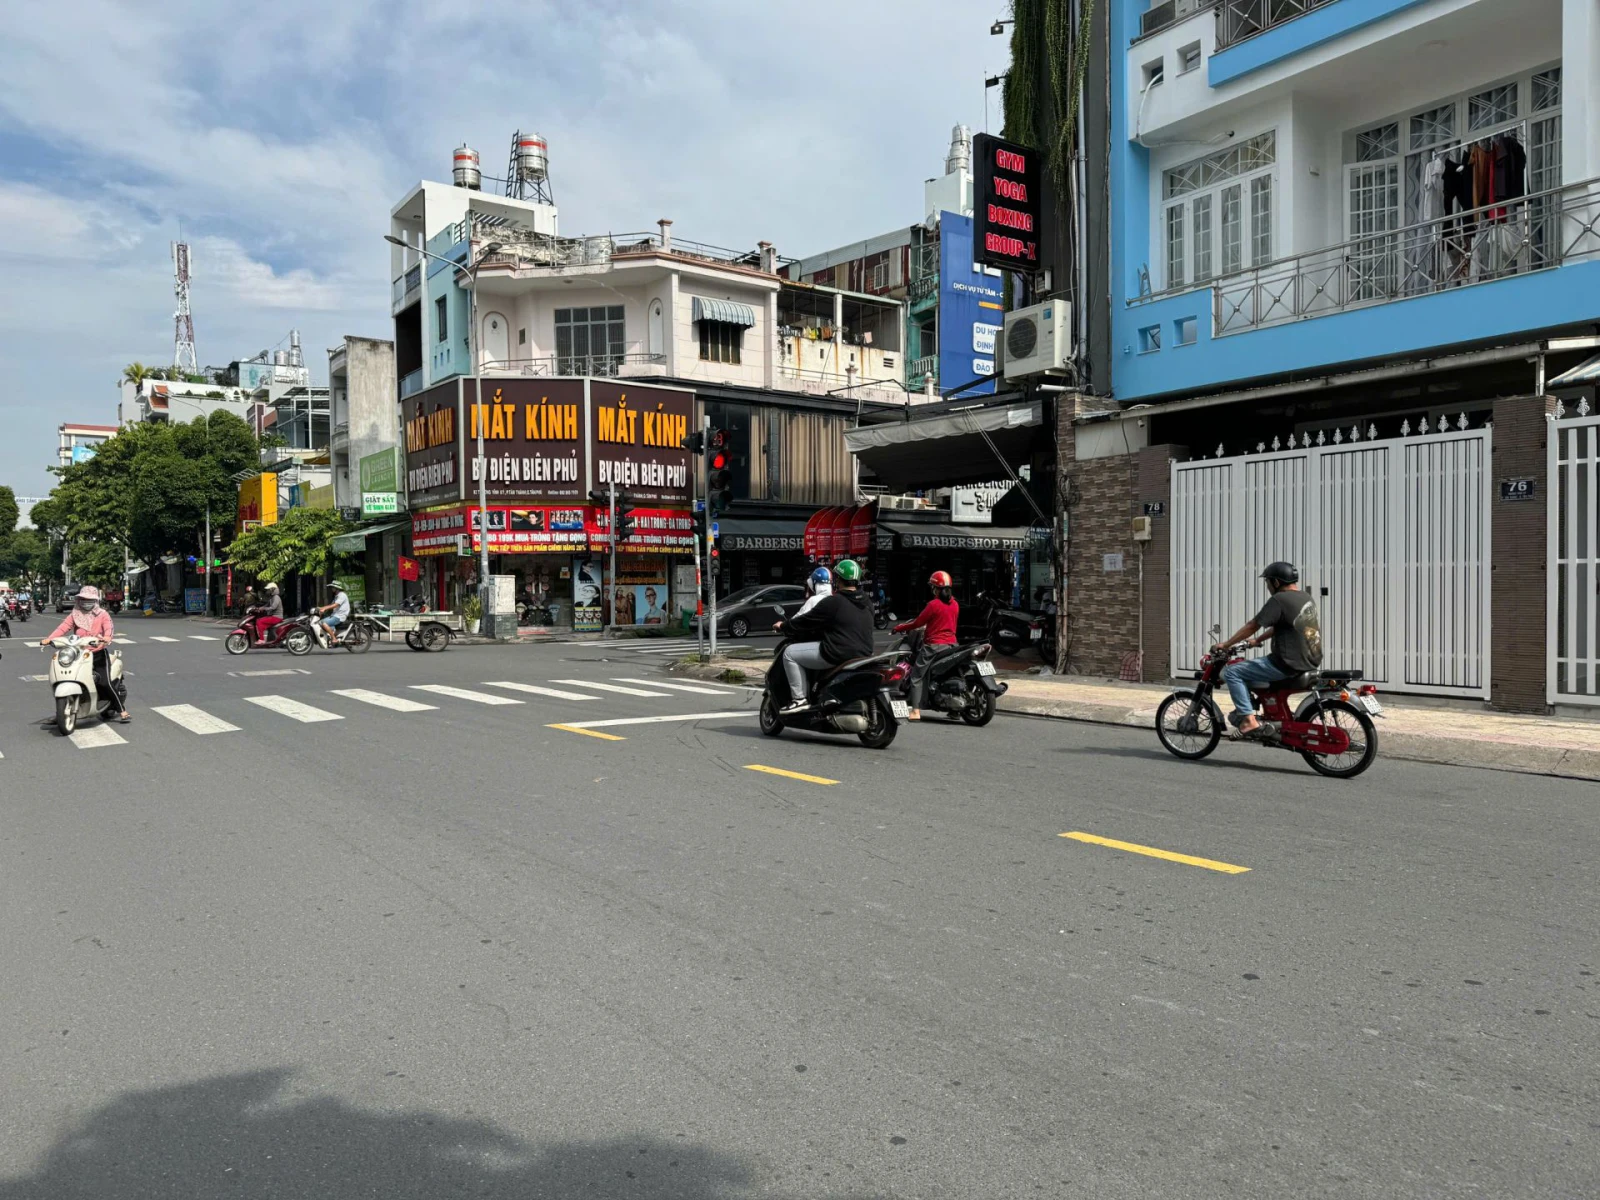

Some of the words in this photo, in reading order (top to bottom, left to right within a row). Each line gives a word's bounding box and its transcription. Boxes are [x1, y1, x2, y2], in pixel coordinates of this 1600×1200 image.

[996, 149, 1025, 173] GYM
[993, 176, 1028, 202] YOGA
[988, 204, 1033, 232] BOXING
[985, 232, 1037, 260] GROUP-X
[953, 282, 968, 291] DỊCH
[975, 326, 986, 335] DU
[976, 341, 994, 351] ĐỊNH
[976, 361, 991, 372] ĐÀO
[470, 388, 516, 440] MẮT
[525, 396, 578, 441] KÍNH
[598, 393, 638, 445] MẮT
[643, 402, 687, 449] KÍNH
[406, 402, 426, 454] MẮT
[427, 403, 455, 448] KÍNH
[489, 451, 520, 485] ĐIỆN
[522, 451, 551, 482] BIÊN
[553, 448, 578, 482] PHỦ
[599, 459, 613, 483] BV
[613, 456, 639, 488] ĐIỆN
[641, 459, 665, 487] BIÊN
[666, 458, 687, 488] PHỦ
[1507, 481, 1527, 492] 76
[1148, 503, 1160, 511] 78
[473, 533, 497, 542] COBO
[552, 532, 569, 544] TẶNG
[569, 533, 587, 544] GỌNG
[913, 536, 999, 549] BARBERSHOP
